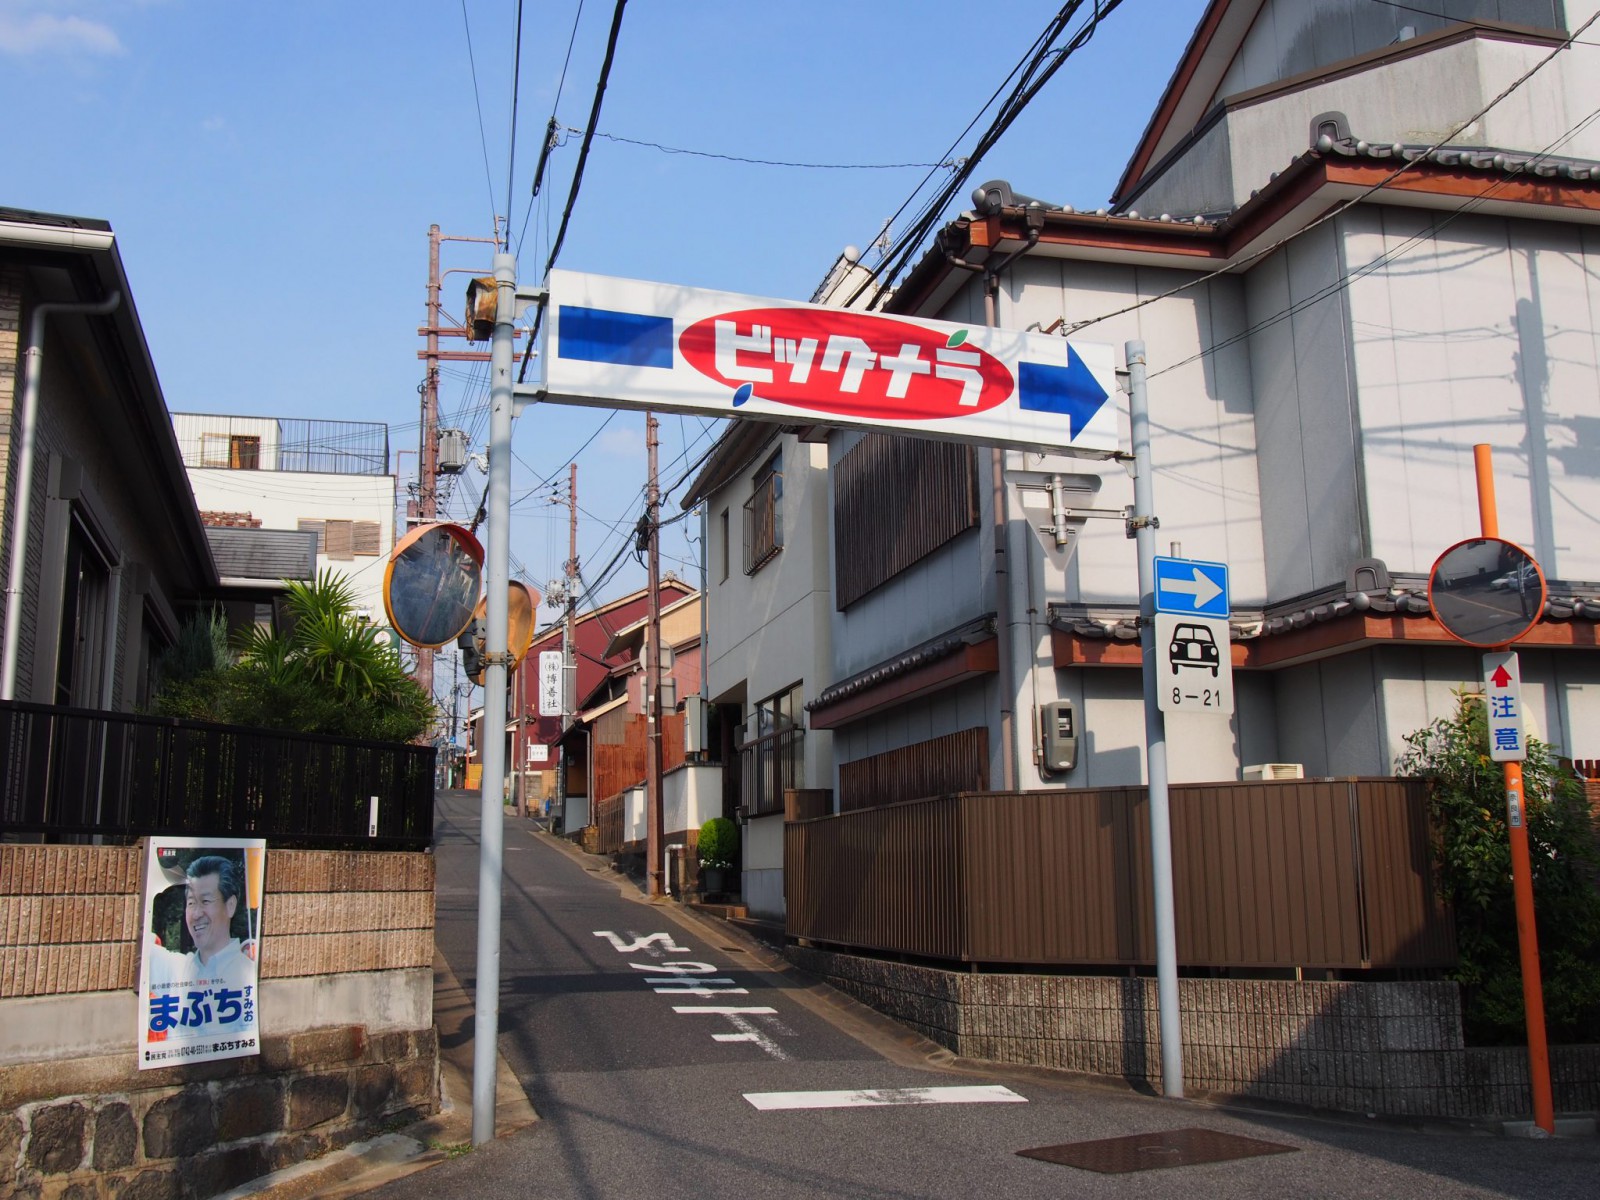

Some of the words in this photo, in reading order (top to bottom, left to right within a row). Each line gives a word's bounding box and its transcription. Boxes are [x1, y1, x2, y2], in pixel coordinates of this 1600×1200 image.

[714, 319, 984, 406] ビッグナラ
[1491, 695, 1520, 751] 注意
[149, 988, 243, 1032] まぶち
[243, 985, 254, 1023] すみお
[212, 1038, 256, 1053] まぶちすみお
